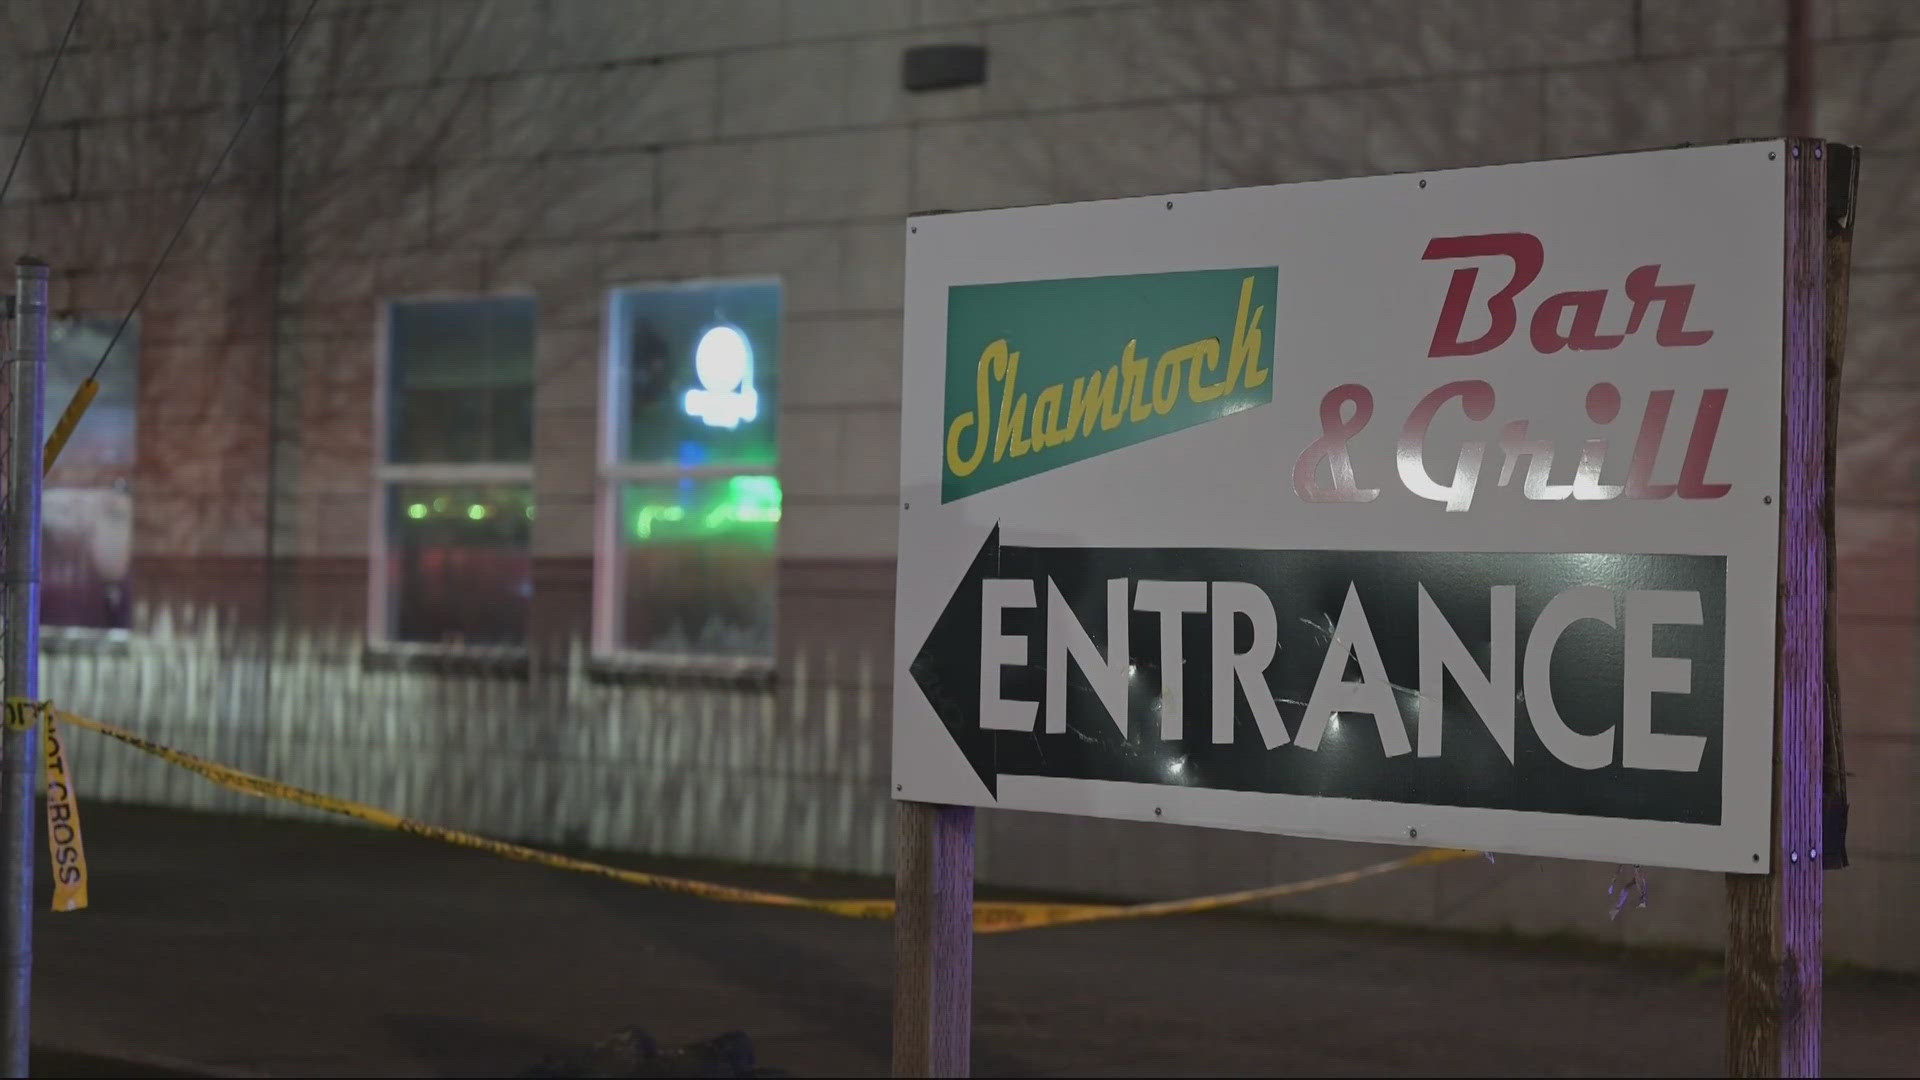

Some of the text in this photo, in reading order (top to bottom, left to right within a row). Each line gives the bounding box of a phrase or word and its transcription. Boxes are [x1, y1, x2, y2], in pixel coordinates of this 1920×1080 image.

[1421, 232, 1713, 358] Bar
[945, 276, 1268, 478] Shamrock
[1291, 380, 1732, 512] & Grill
[979, 574, 1705, 773] ENTRANCE
[49, 783, 81, 885] CROSS
